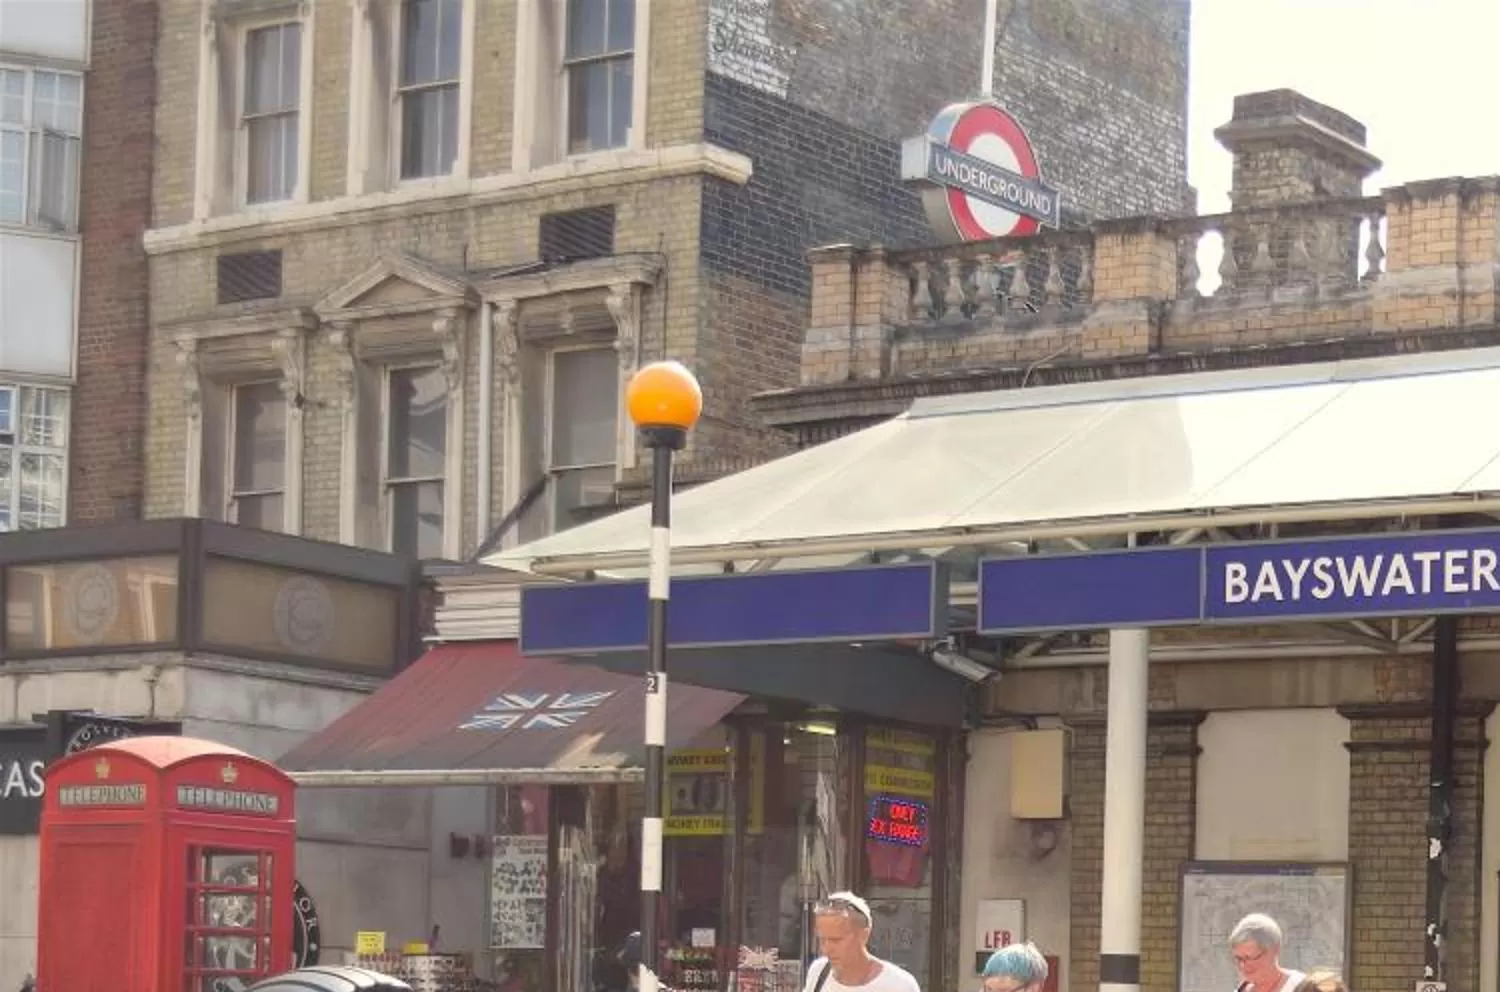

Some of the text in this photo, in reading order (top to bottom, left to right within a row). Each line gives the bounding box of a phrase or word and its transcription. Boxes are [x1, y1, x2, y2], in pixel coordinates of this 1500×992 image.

[934, 152, 1051, 216] UNDERGROUND
[1224, 549, 1500, 603] BAYSWATER
[0, 759, 46, 798] AS
[63, 785, 144, 804] TELEPHONE
[180, 787, 278, 811] TELEPHONE
